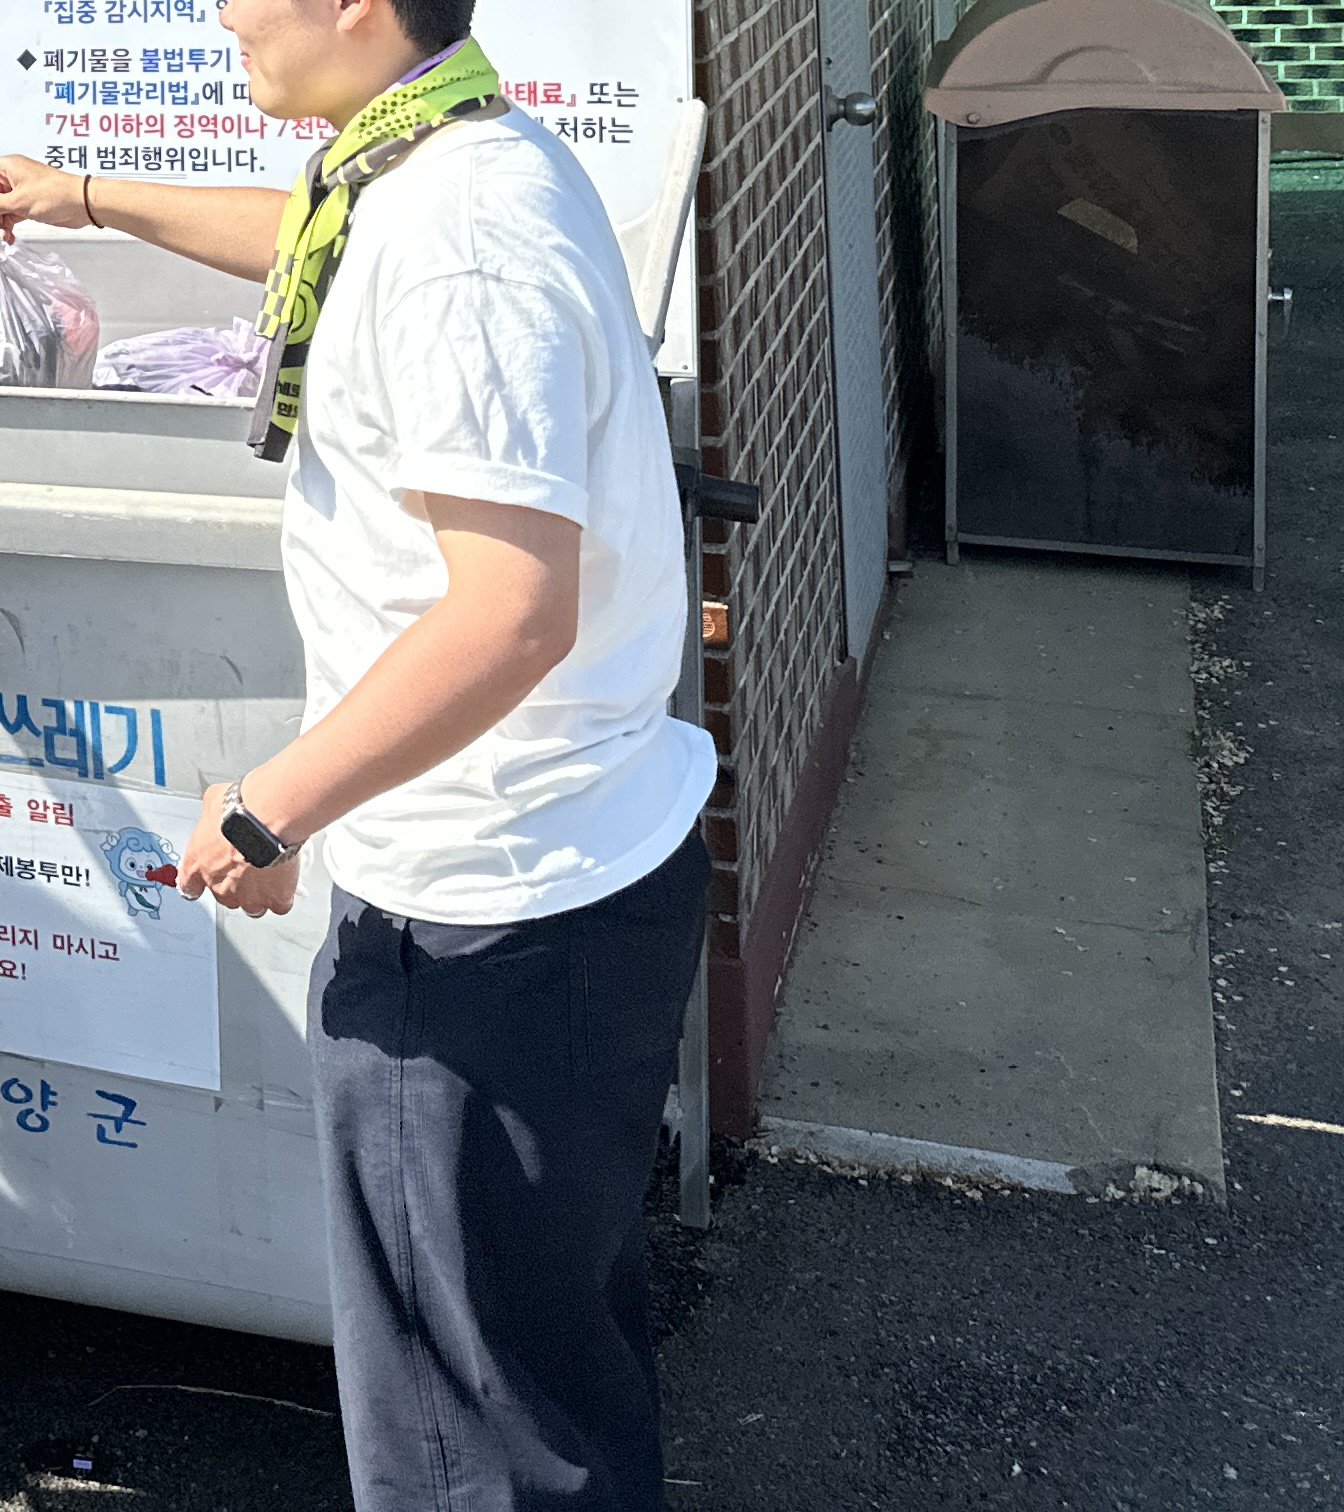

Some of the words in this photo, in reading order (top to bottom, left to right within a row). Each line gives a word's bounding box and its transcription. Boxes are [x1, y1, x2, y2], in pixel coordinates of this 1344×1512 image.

[43, 47, 132, 73] 폐기물을
[139, 47, 231, 73] 불법투기
[587, 80, 640, 108] 또는
[99, 113, 165, 138] 이하의
[174, 113, 268, 139] 징역이나
[555, 117, 634, 144] 처하는
[44, 145, 88, 170] 중대
[96, 146, 265, 173] 범죄행위입니다.
[27, 798, 75, 827] 알림
[52, 934, 121, 962] 마시고
